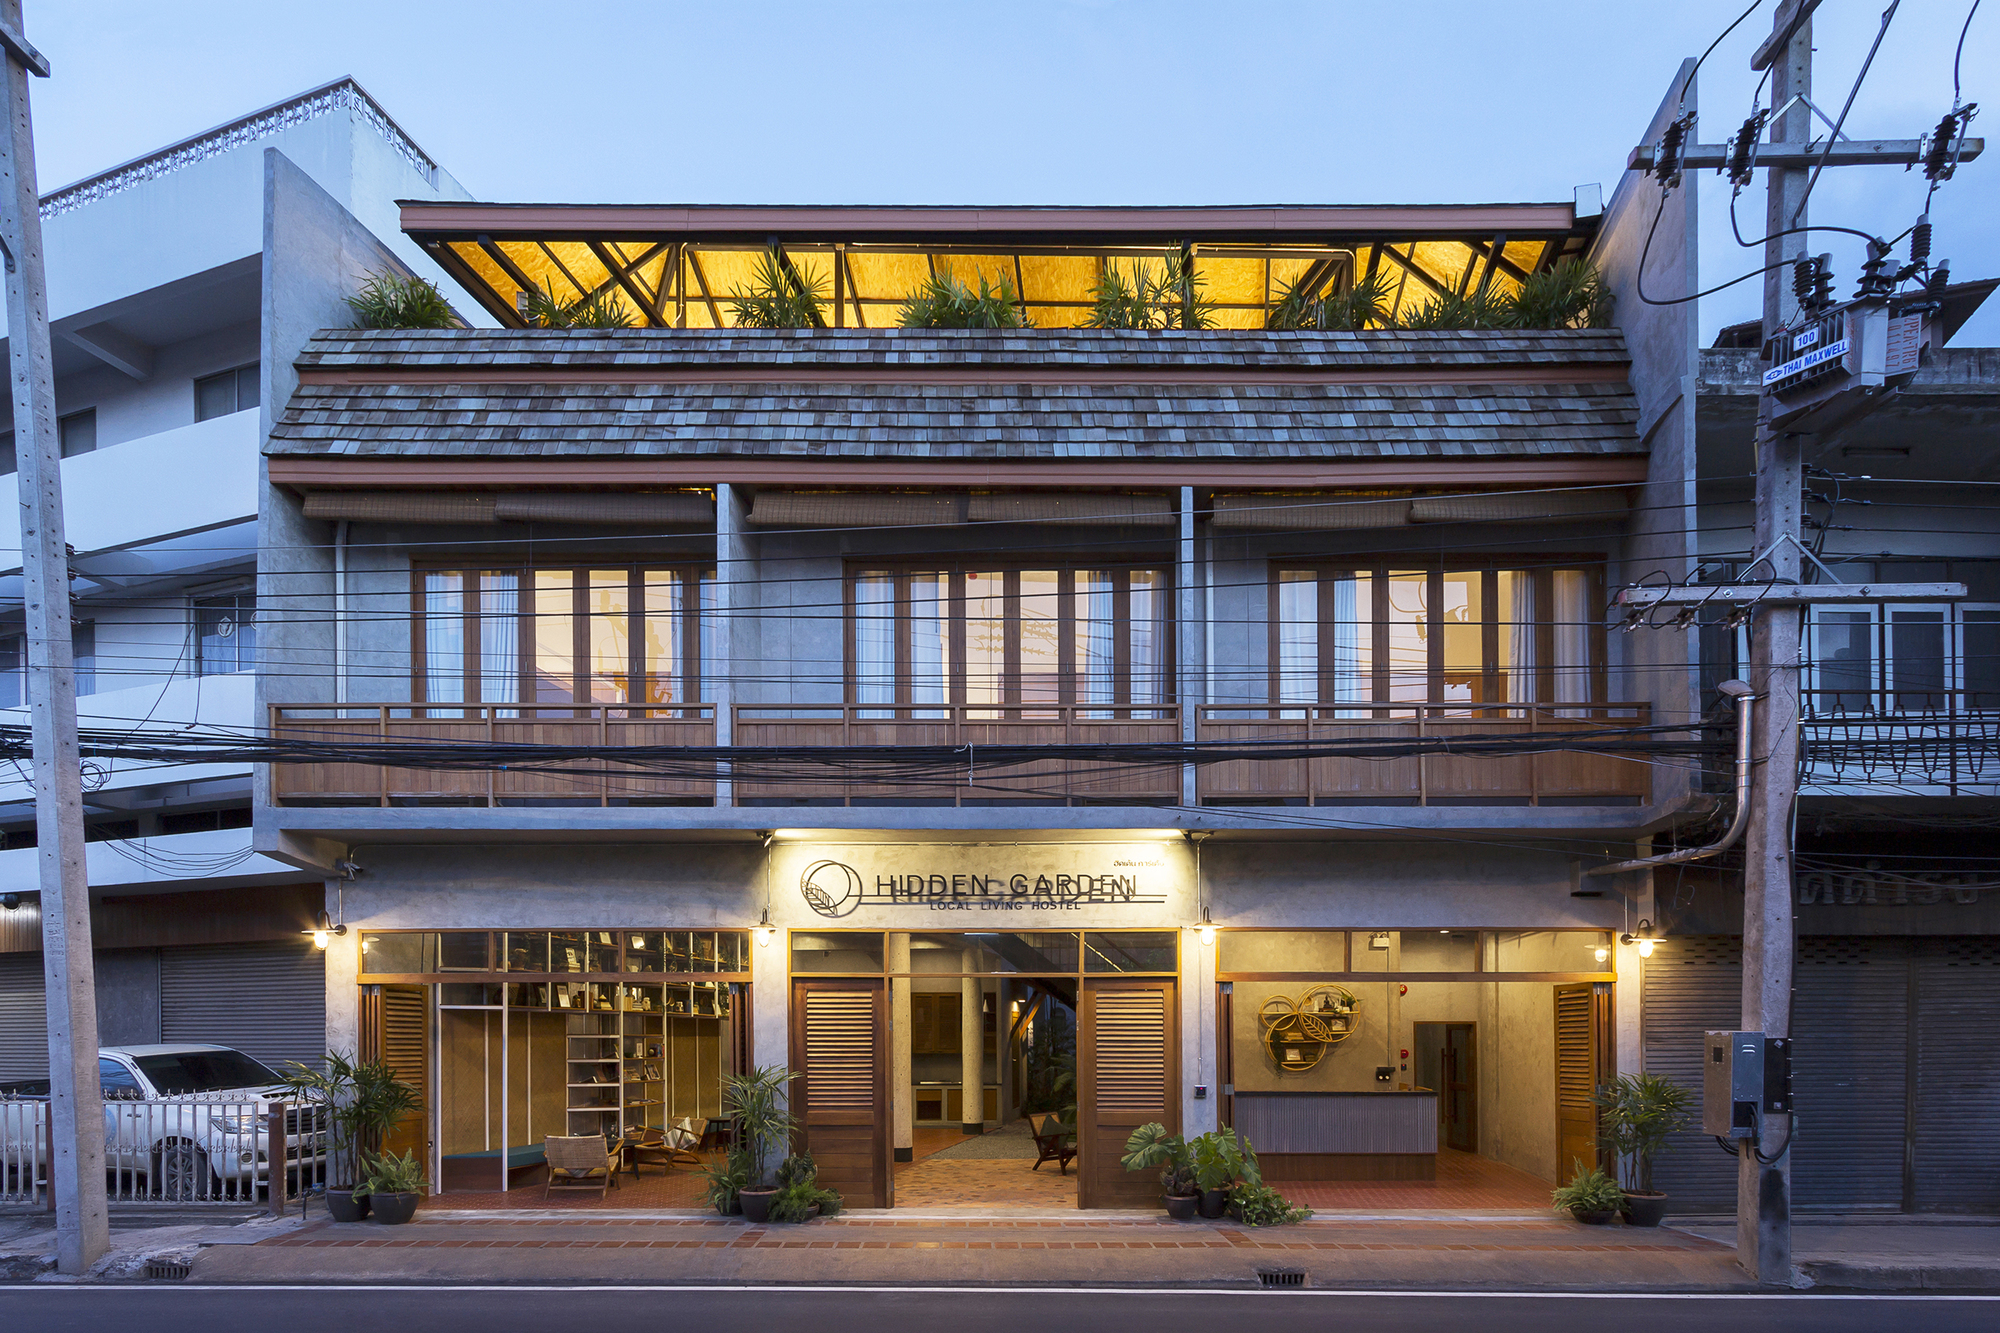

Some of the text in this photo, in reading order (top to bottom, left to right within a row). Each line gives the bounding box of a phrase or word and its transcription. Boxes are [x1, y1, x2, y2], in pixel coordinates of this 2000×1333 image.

[1797, 331, 1815, 347] 100
[1783, 340, 1847, 376] THAI MAXWELL
[877, 874, 1137, 896] HIDDEN GARDEN
[929, 901, 1082, 911] LOCAL LIVING HOSTEL
